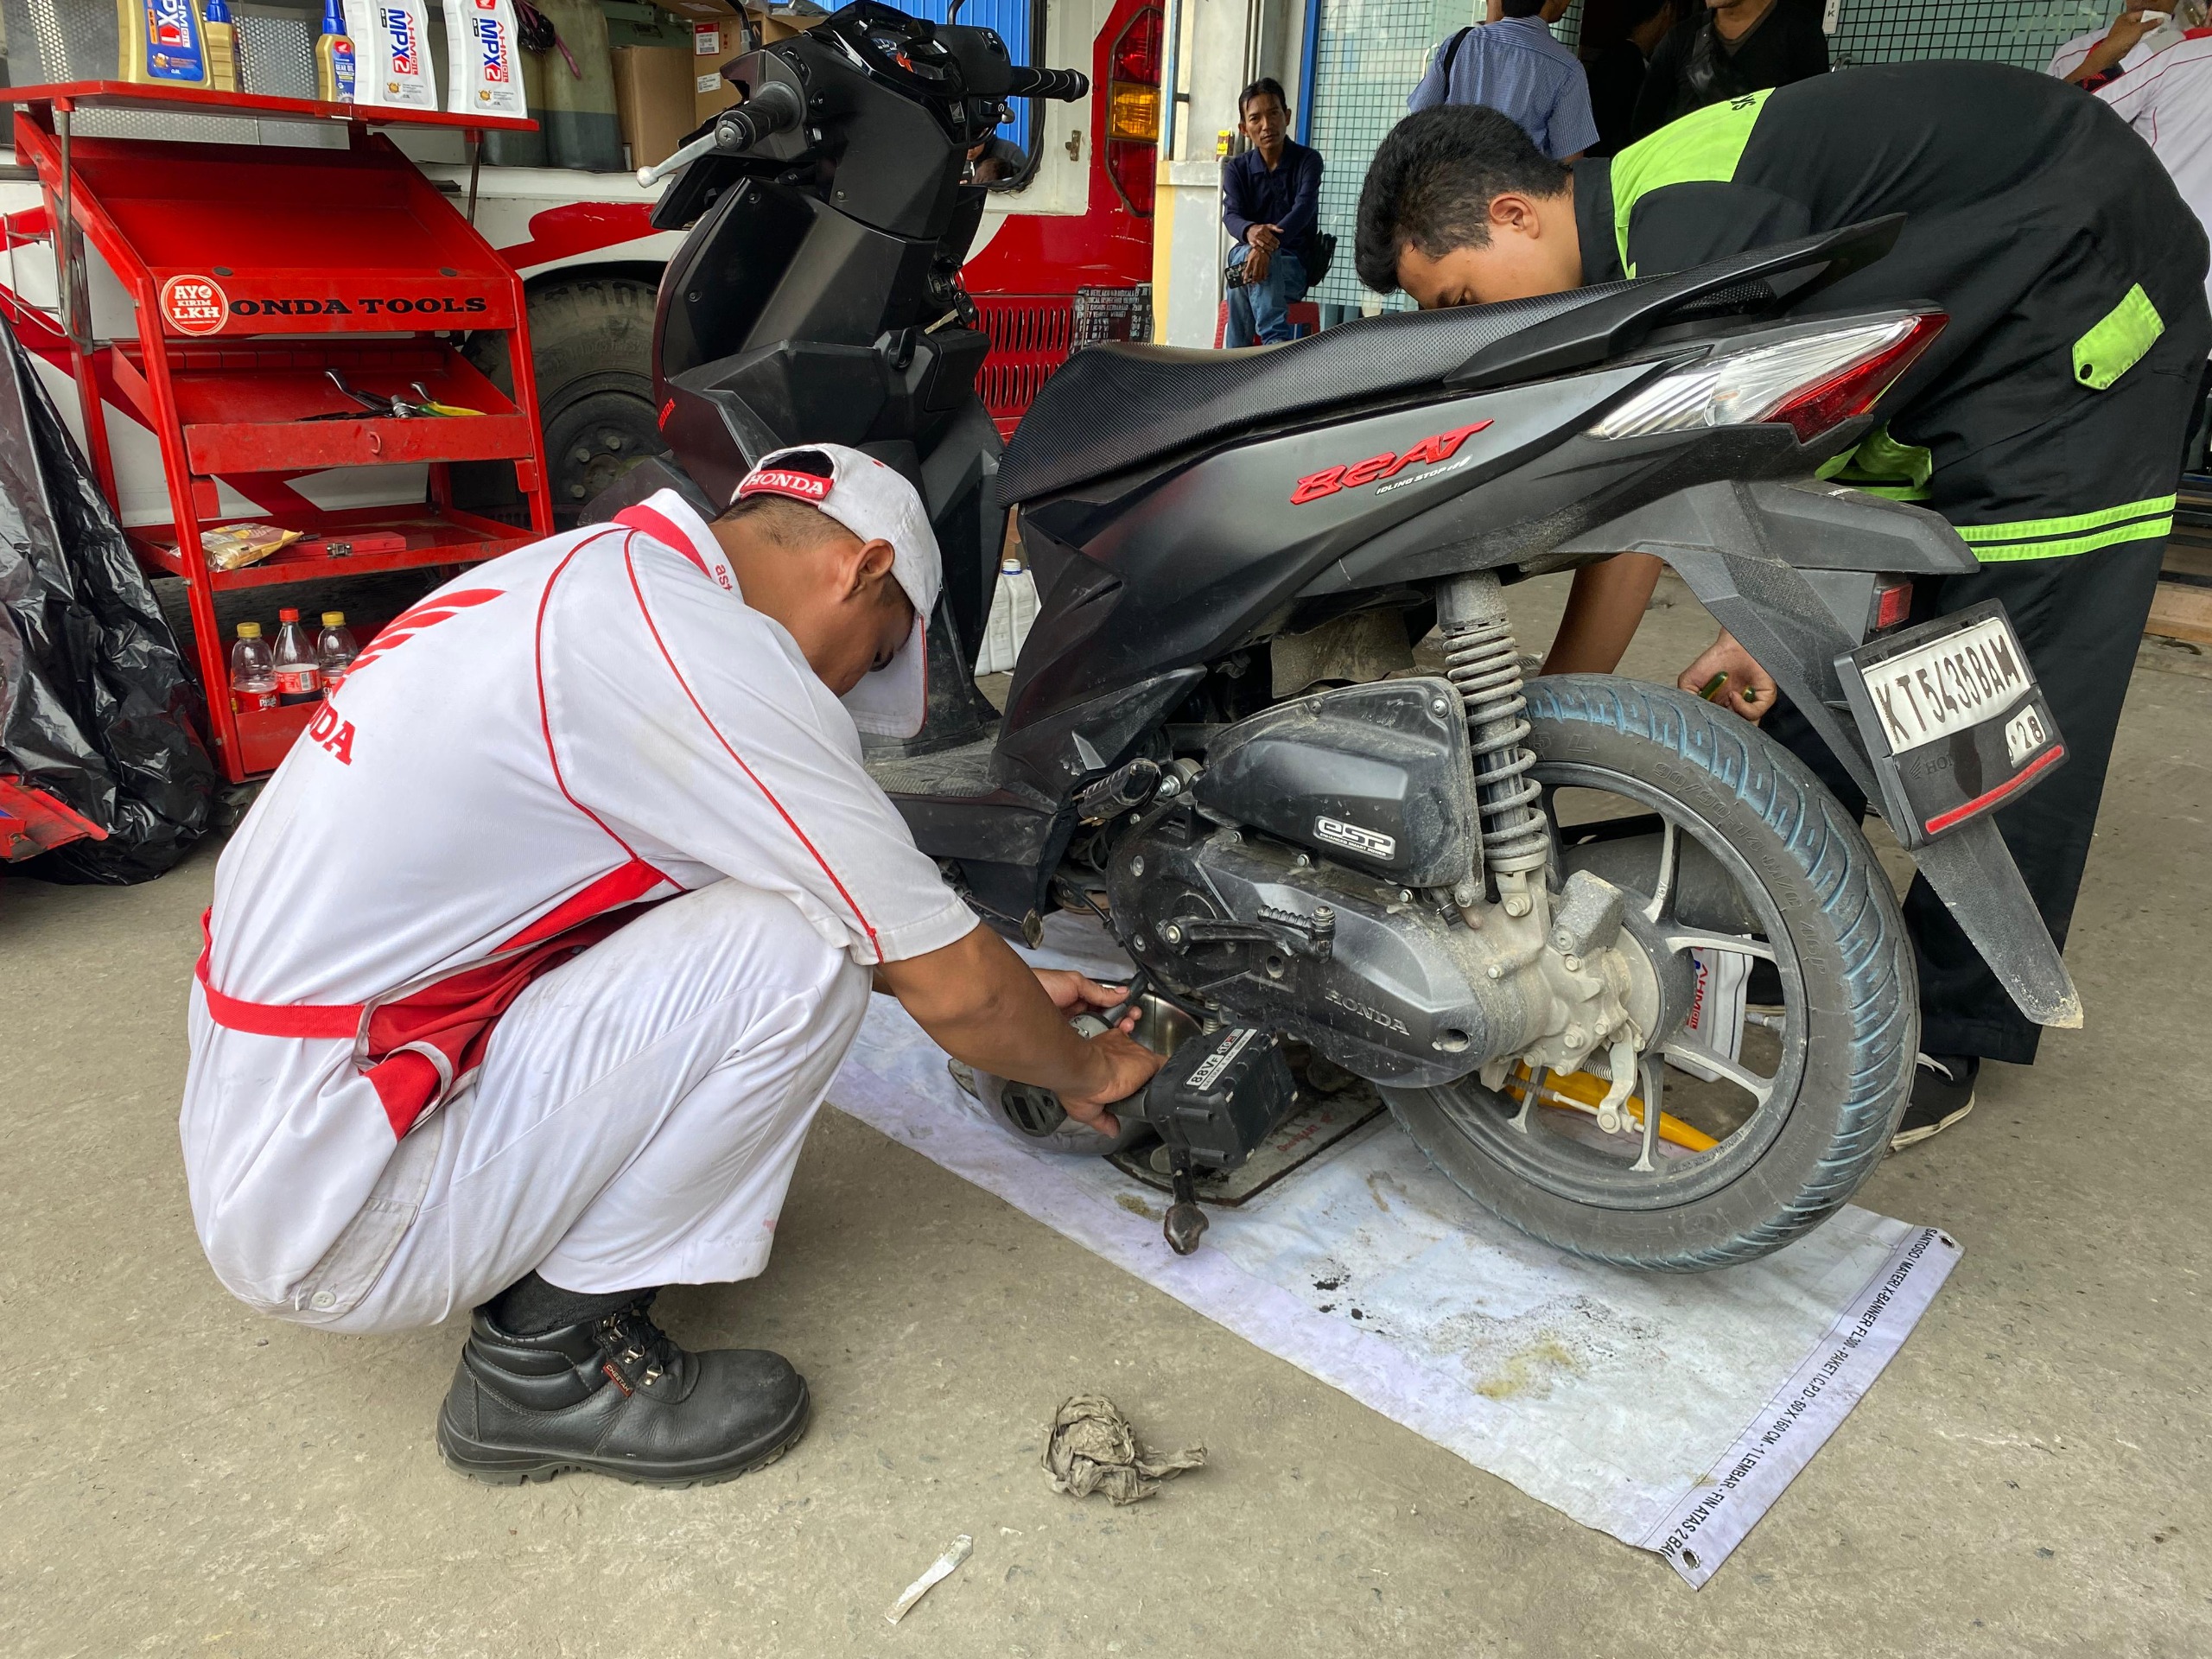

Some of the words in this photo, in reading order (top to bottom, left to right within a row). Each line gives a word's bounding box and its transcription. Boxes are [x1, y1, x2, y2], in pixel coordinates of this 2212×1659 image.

[387, 9, 411, 74] MPX2
[480, 18, 502, 81] MPX2
[172, 306, 220, 319] LKH
[229, 298, 353, 315] ONDA
[358, 297, 487, 315] TOOLS
[746, 473, 824, 495] HONDA
[1376, 477, 1414, 495] IDLING
[1414, 466, 1447, 483] STOP
[1875, 674, 1927, 744] KT
[1915, 653, 1982, 723] 5435
[1965, 634, 2021, 699] BAM
[1348, 841, 1367, 851] SMART
[1367, 848, 1387, 857] POWER
[1325, 988, 1410, 1036] HONDA
[1908, 1228, 1937, 1259] SANTOSO
[1887, 1261, 1914, 1289] MATERI
[1859, 1286, 1896, 1327] X-BANNER
[1821, 1349, 1848, 1376] PAKET
[606, 1364, 630, 1392] CHEETAH
[1784, 1408, 1799, 1419] X
[1790, 1400, 1807, 1412] 60
[1761, 1430, 1781, 1445] CM
[1773, 1417, 1792, 1432] 160
[1719, 1452, 1761, 1489] LEMBAR
[1701, 1491, 1726, 1509] FIN
[1681, 1504, 1710, 1532] ATAS
[1675, 1528, 1689, 1540] 2
